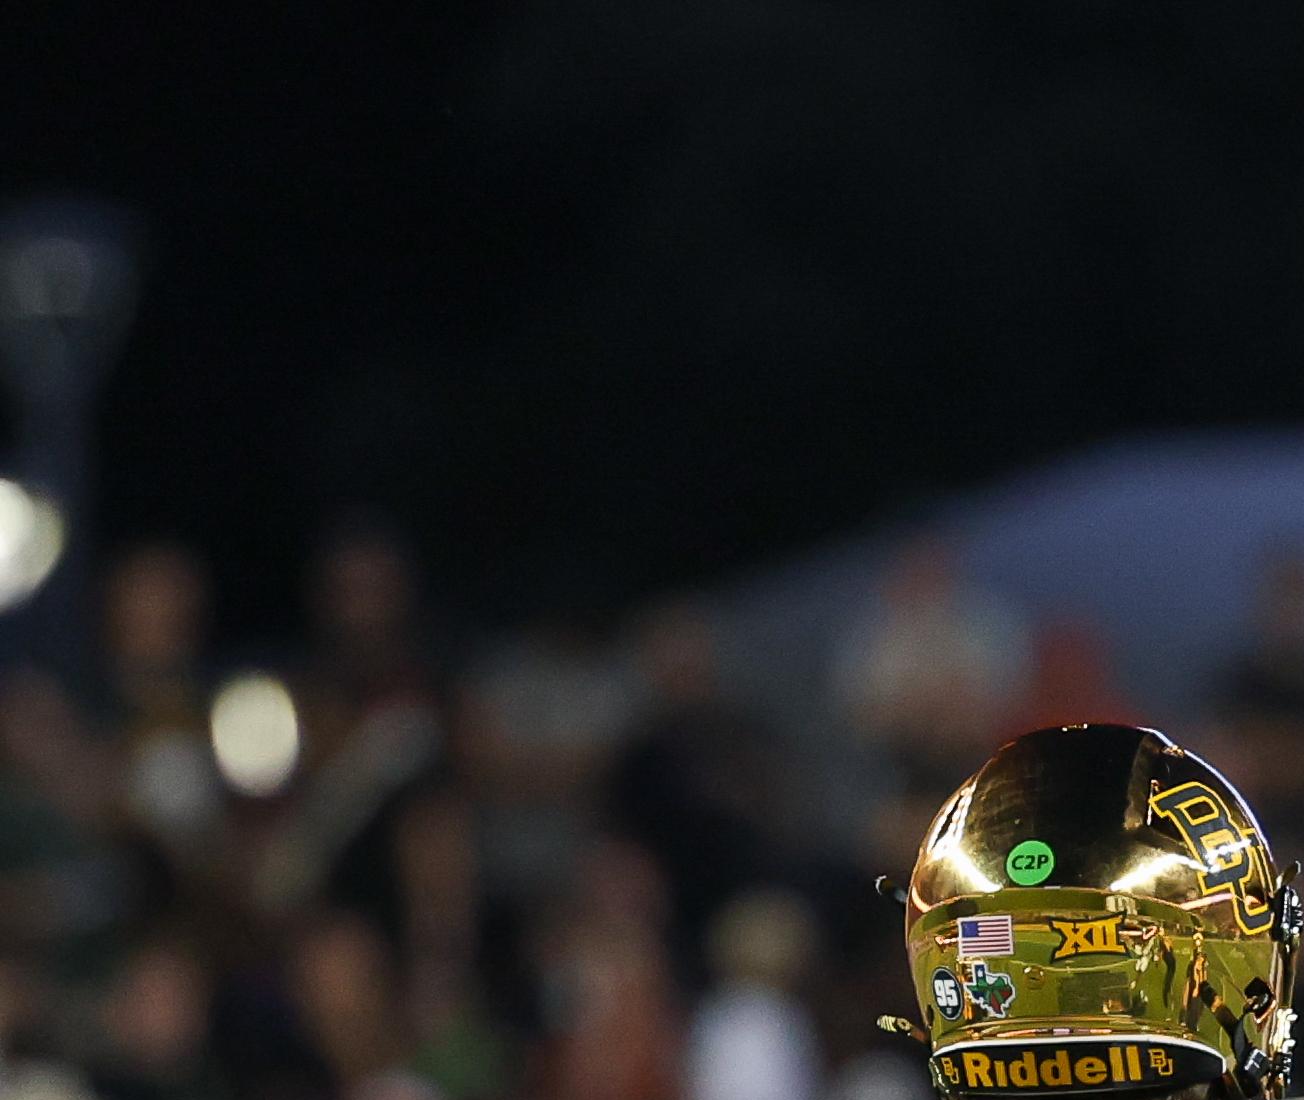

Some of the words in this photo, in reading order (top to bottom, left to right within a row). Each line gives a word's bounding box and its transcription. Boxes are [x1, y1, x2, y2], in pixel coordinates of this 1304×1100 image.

[1011, 854, 1049, 871] C2P
[934, 979, 958, 1007] 95
[962, 1045, 1142, 1088] Riddell
